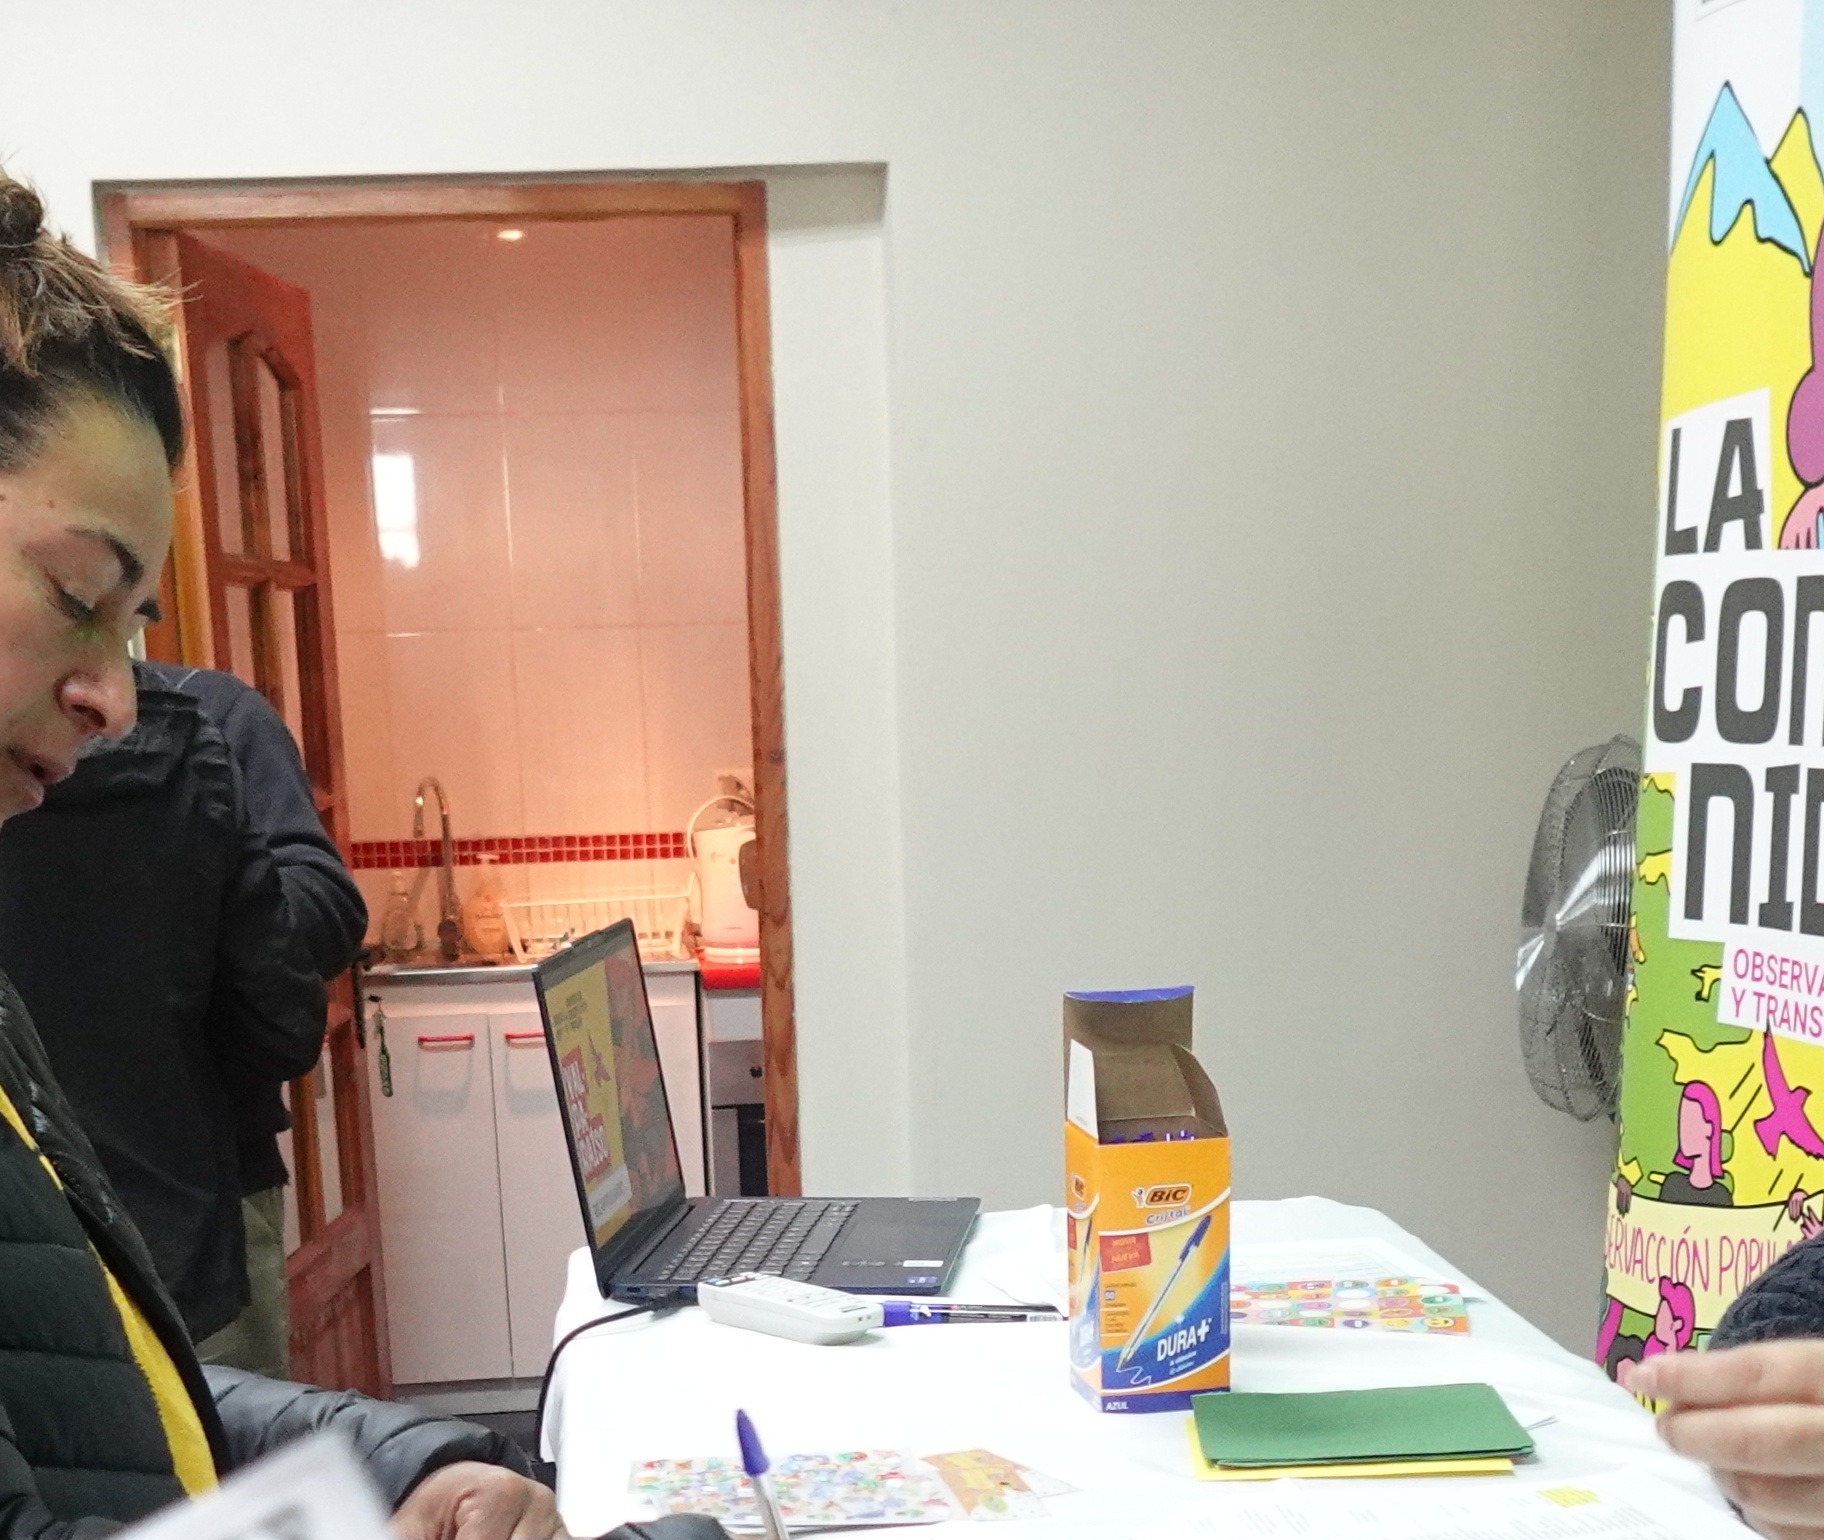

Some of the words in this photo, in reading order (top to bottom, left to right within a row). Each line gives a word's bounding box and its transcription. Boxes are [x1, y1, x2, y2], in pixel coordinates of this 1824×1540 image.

[1664, 417, 1765, 556] LA
[1731, 986, 1747, 1018] Y
[1156, 1318, 1211, 1362] DURA+
[1105, 1400, 1129, 1411] AZUL
